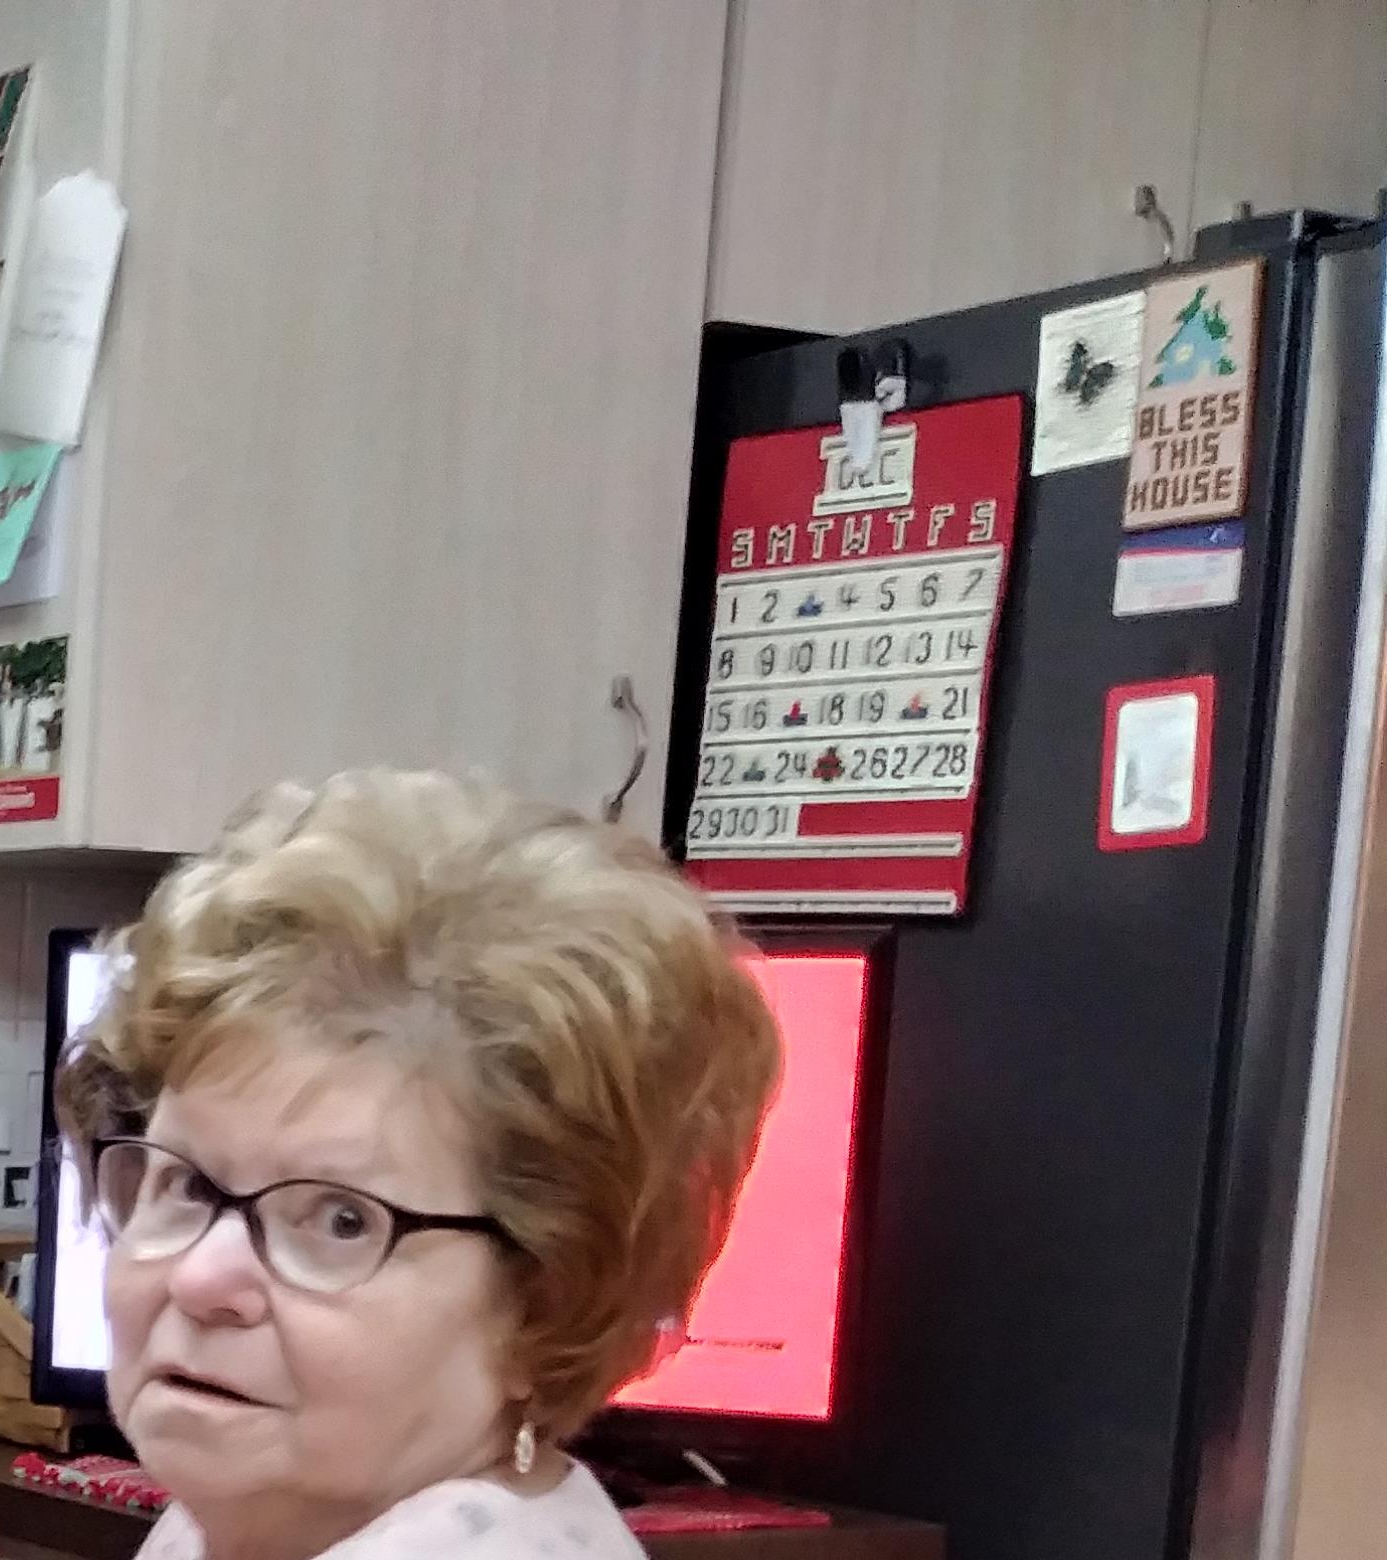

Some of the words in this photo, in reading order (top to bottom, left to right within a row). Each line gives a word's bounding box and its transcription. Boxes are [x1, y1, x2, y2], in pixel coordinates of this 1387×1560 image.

[1139, 390, 1240, 439] BLESS
[1151, 432, 1220, 473] THIS
[1130, 466, 1234, 512] HOUSE
[731, 528, 754, 567] S
[767, 522, 796, 565] M
[808, 519, 834, 559] T
[840, 515, 870, 555] W
[887, 508, 915, 551] T
[927, 503, 955, 546] F
[967, 499, 996, 542] S
[761, 589, 779, 623] 2
[879, 576, 901, 611] 5
[920, 572, 941, 607] 6
[717, 649, 735, 680] 8
[757, 642, 776, 677] 9
[789, 640, 814, 674] 10
[830, 640, 850, 670] 11
[863, 634, 893, 667] 12
[904, 631, 933, 664] 13
[944, 629, 979, 661] 14
[706, 699, 734, 733] 15
[743, 699, 768, 731] 16
[818, 693, 845, 726] 18
[858, 691, 886, 723] 19
[942, 687, 969, 720] 21
[701, 754, 736, 787] 22
[774, 750, 807, 783] 24
[850, 748, 888, 781] 26
[890, 745, 930, 780] 27
[932, 742, 967, 777] 28
[689, 808, 722, 841] 29
